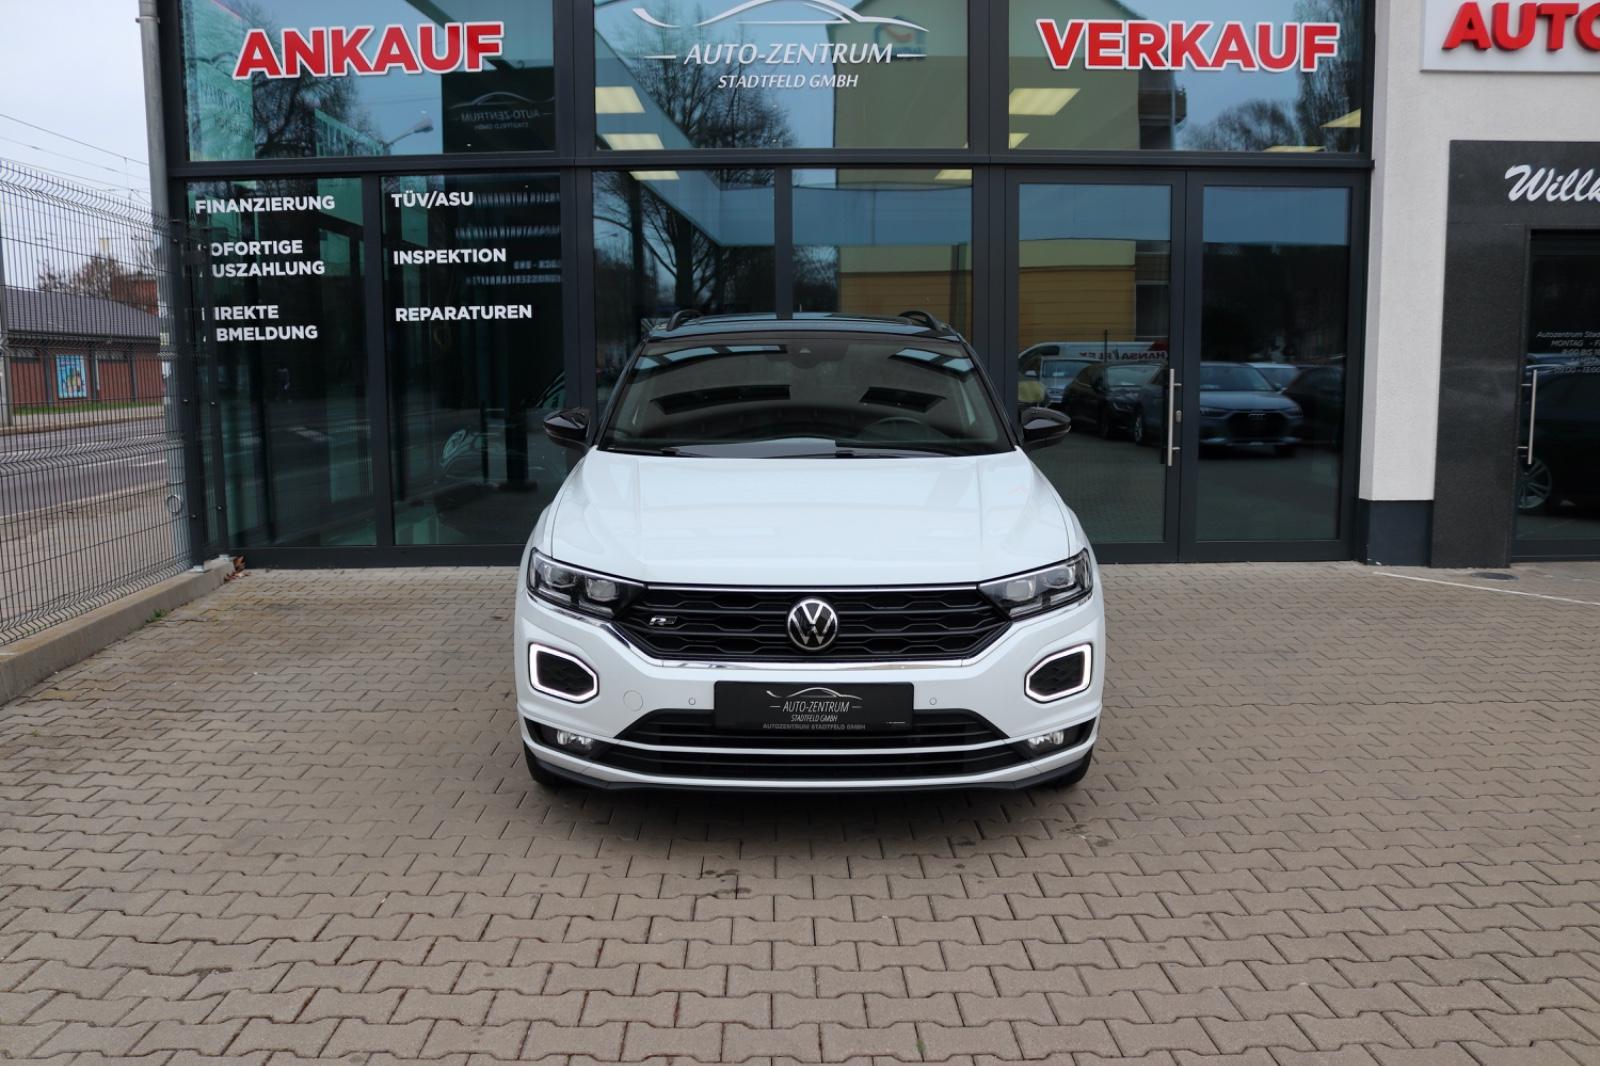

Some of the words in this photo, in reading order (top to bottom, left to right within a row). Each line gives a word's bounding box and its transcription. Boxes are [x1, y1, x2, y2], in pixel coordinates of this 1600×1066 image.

[232, 21, 505, 80] ANKAUF
[683, 43, 893, 65] AUTO-ZENTRUM
[1036, 18, 1340, 73] VERKAUF
[717, 74, 805, 89] STADTFELD
[809, 74, 860, 89] GMBH
[195, 195, 336, 214] FINANZIERUNG
[391, 190, 474, 209] TÜV/ASU
[198, 239, 304, 257] OFORTIGE
[393, 248, 507, 265] INSPEKTION
[199, 260, 326, 278] USZAHLUNG
[201, 304, 280, 321] IREKTE
[395, 304, 533, 322] REPARATUREN
[202, 325, 319, 343] BMELDUNG
[782, 701, 850, 712] AUTO-ZENTRUM
[790, 714, 819, 722] STADTFELD
